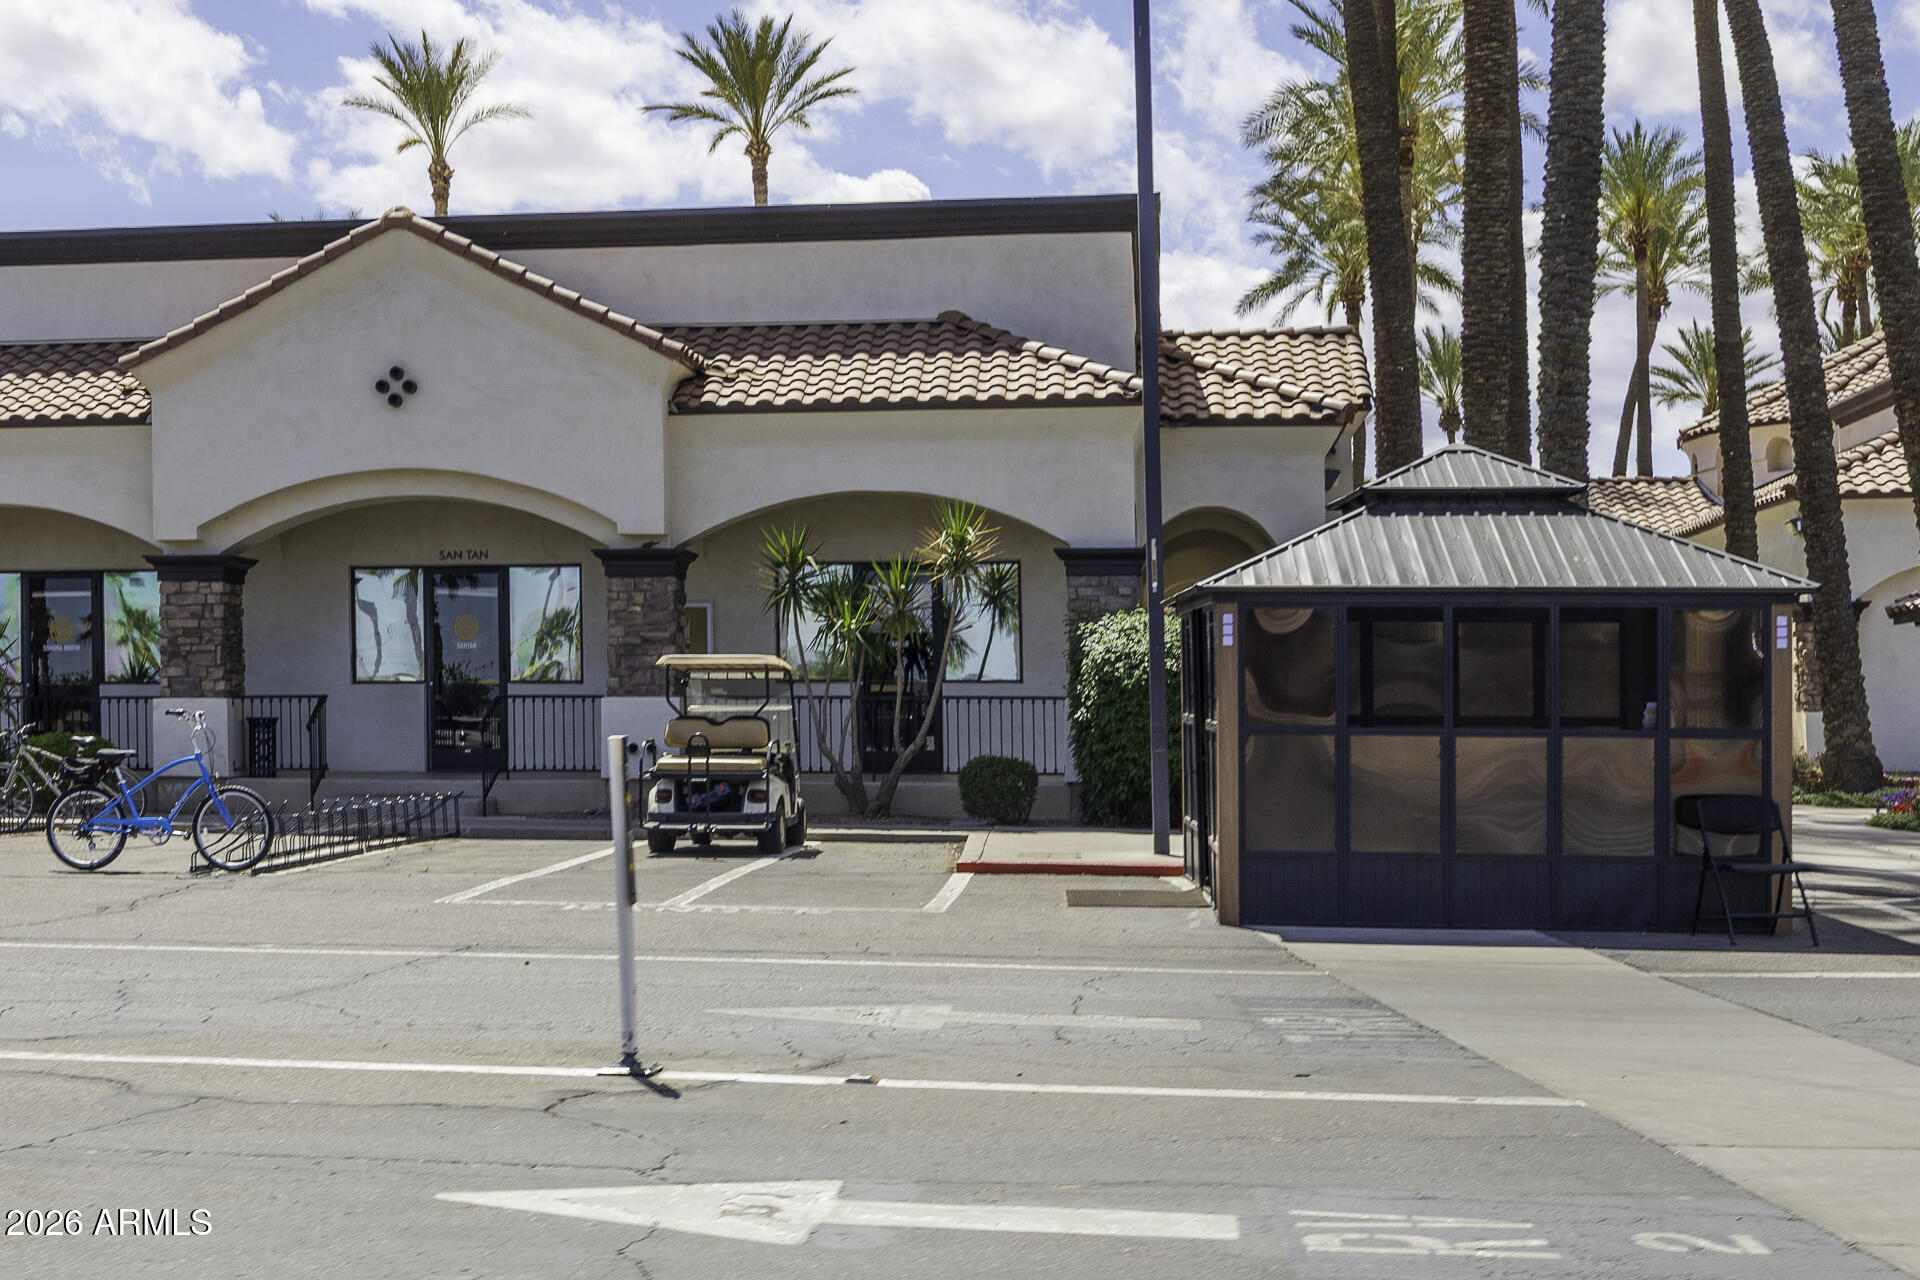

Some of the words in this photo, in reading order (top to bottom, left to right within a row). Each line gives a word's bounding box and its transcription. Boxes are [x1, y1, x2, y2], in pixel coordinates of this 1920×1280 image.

[439, 550, 463, 561] SAN
[466, 550, 489, 561] TAN
[1629, 1231, 1774, 1256] 2
